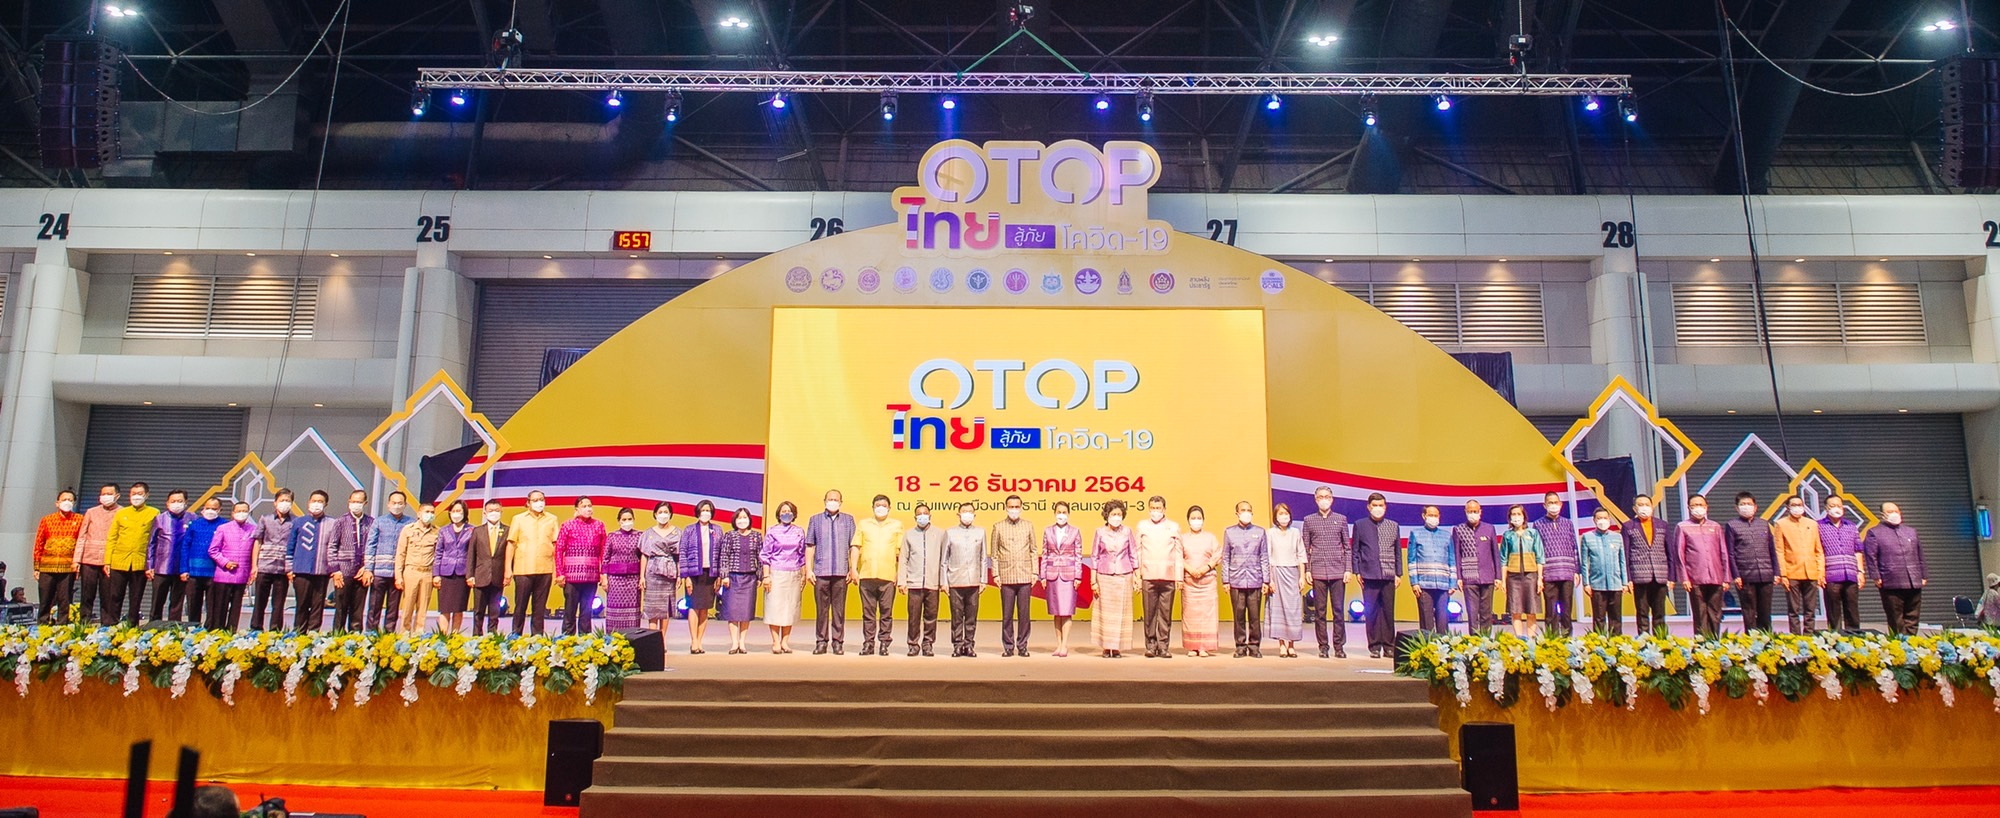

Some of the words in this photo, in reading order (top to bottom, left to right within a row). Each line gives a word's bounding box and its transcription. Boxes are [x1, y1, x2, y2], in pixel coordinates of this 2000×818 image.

[923, 145, 1155, 205] OTOP
[37, 213, 70, 240] 24
[416, 215, 450, 242] 25
[810, 217, 844, 241] 26
[900, 197, 1000, 249] ไทย
[1014, 226, 1046, 247] สู้ภัย
[1060, 223, 1169, 250] โควิด-19
[1206, 219, 1238, 246] 27
[1601, 221, 1634, 248] 28
[1982, 220, 2000, 248] 2
[909, 358, 1140, 410] OTOP
[886, 404, 985, 450] ไทย
[999, 429, 1032, 448] สู้ภัย
[1044, 426, 1154, 450] โควิด-19
[894, 476, 921, 492] 18
[948, 476, 979, 492] 26
[987, 473, 1076, 492] ธันวาคม
[1084, 476, 1146, 492] 2564
[897, 502, 911, 511] ณ
